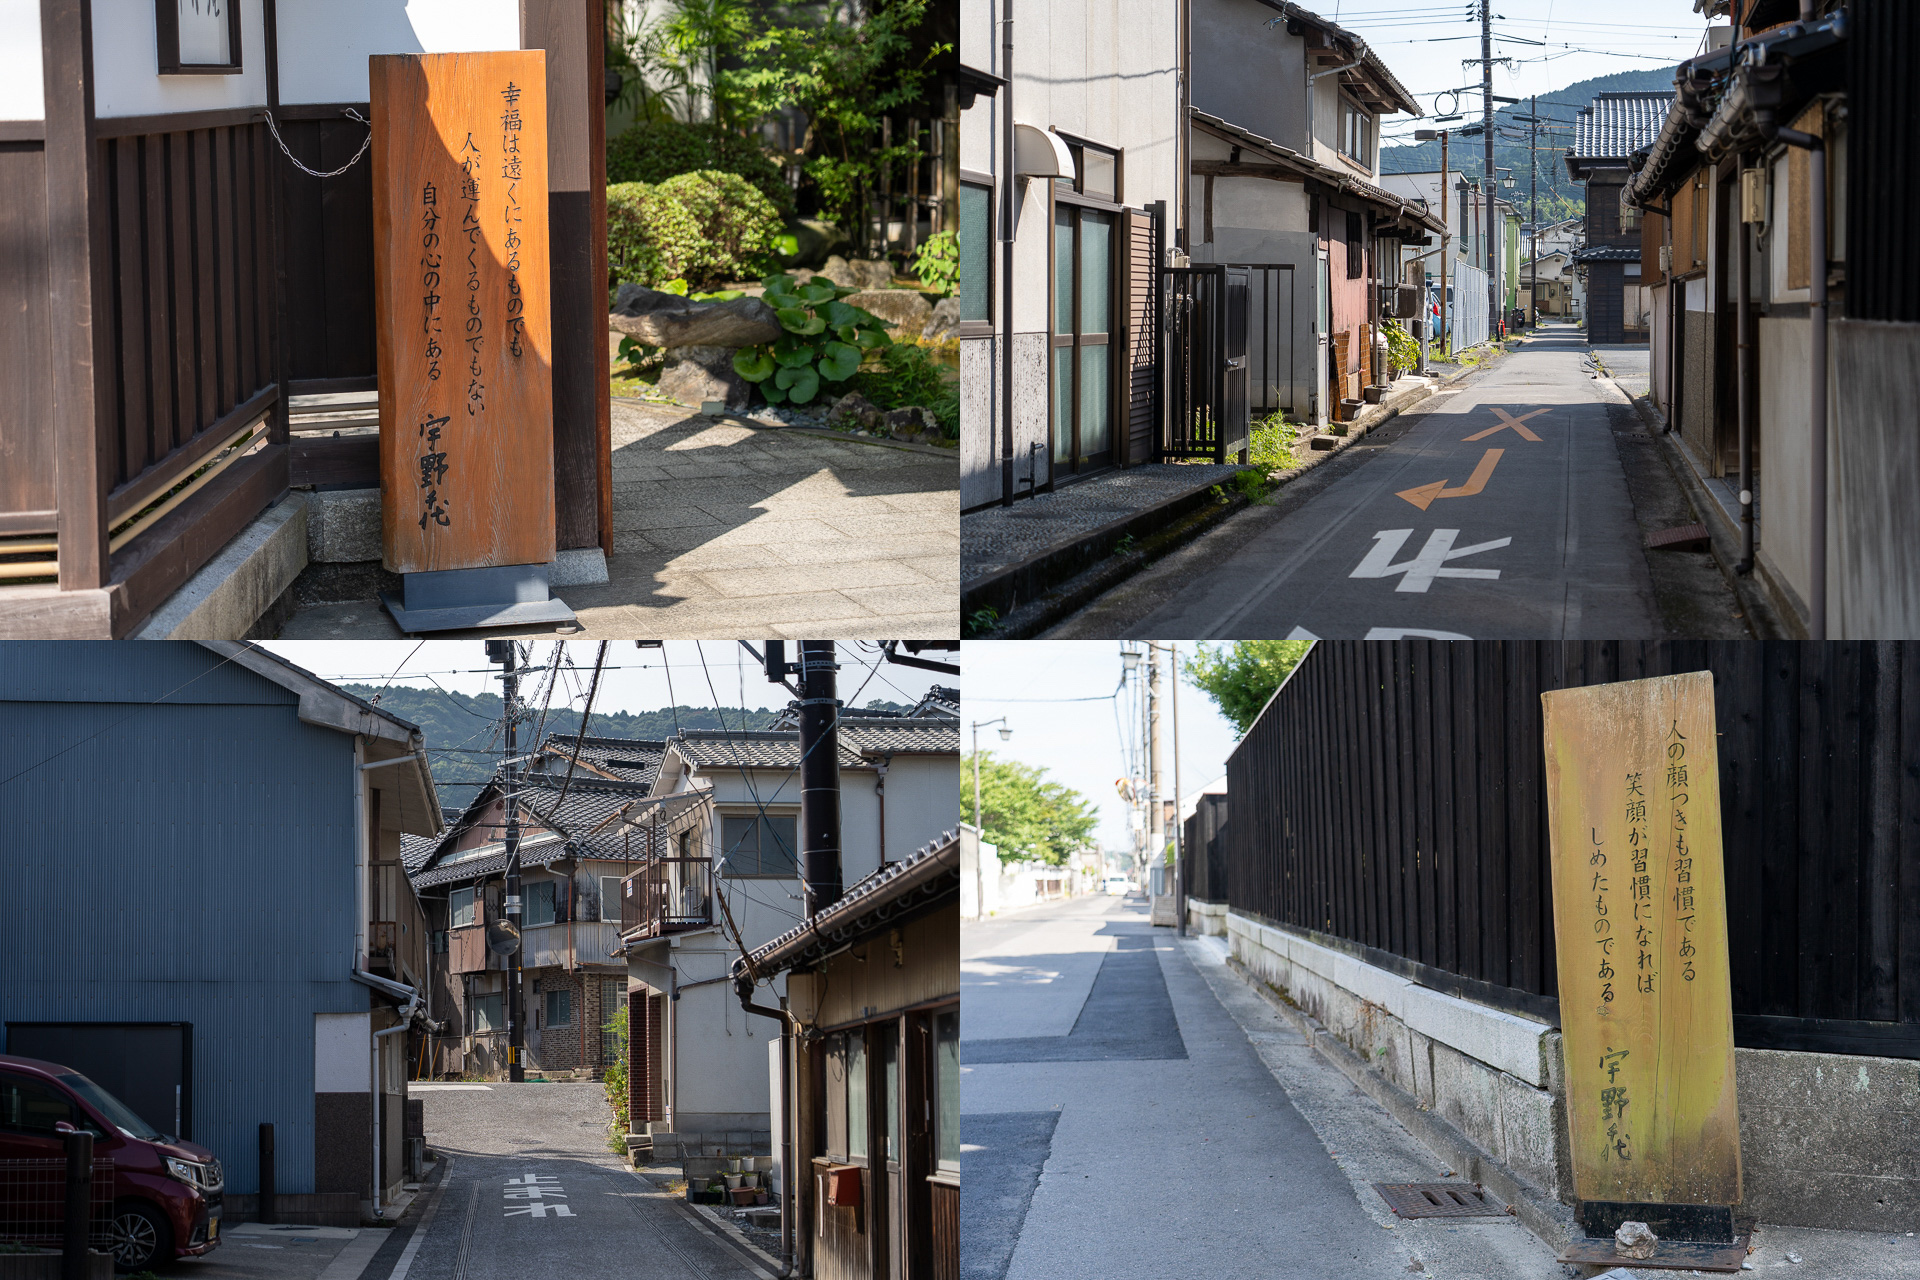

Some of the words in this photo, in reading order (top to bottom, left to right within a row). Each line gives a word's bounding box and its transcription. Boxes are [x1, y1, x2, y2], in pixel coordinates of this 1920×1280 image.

[420, 181, 442, 380] 自分の心の中にある
[460, 132, 485, 416] 人が運んでくるものでもない
[500, 81, 525, 358] 幸福は遠くにあるものでも
[419, 413, 451, 530] 宇野千代
[1589, 827, 1615, 1003] しめたものである
[1625, 773, 1656, 994] 笑顔が習慣になれば
[1666, 719, 1696, 982] 人の顔つきも習慣である
[504, 1174, 577, 1217] 止まれ
[1599, 1046, 1632, 1161] 宇野千代
